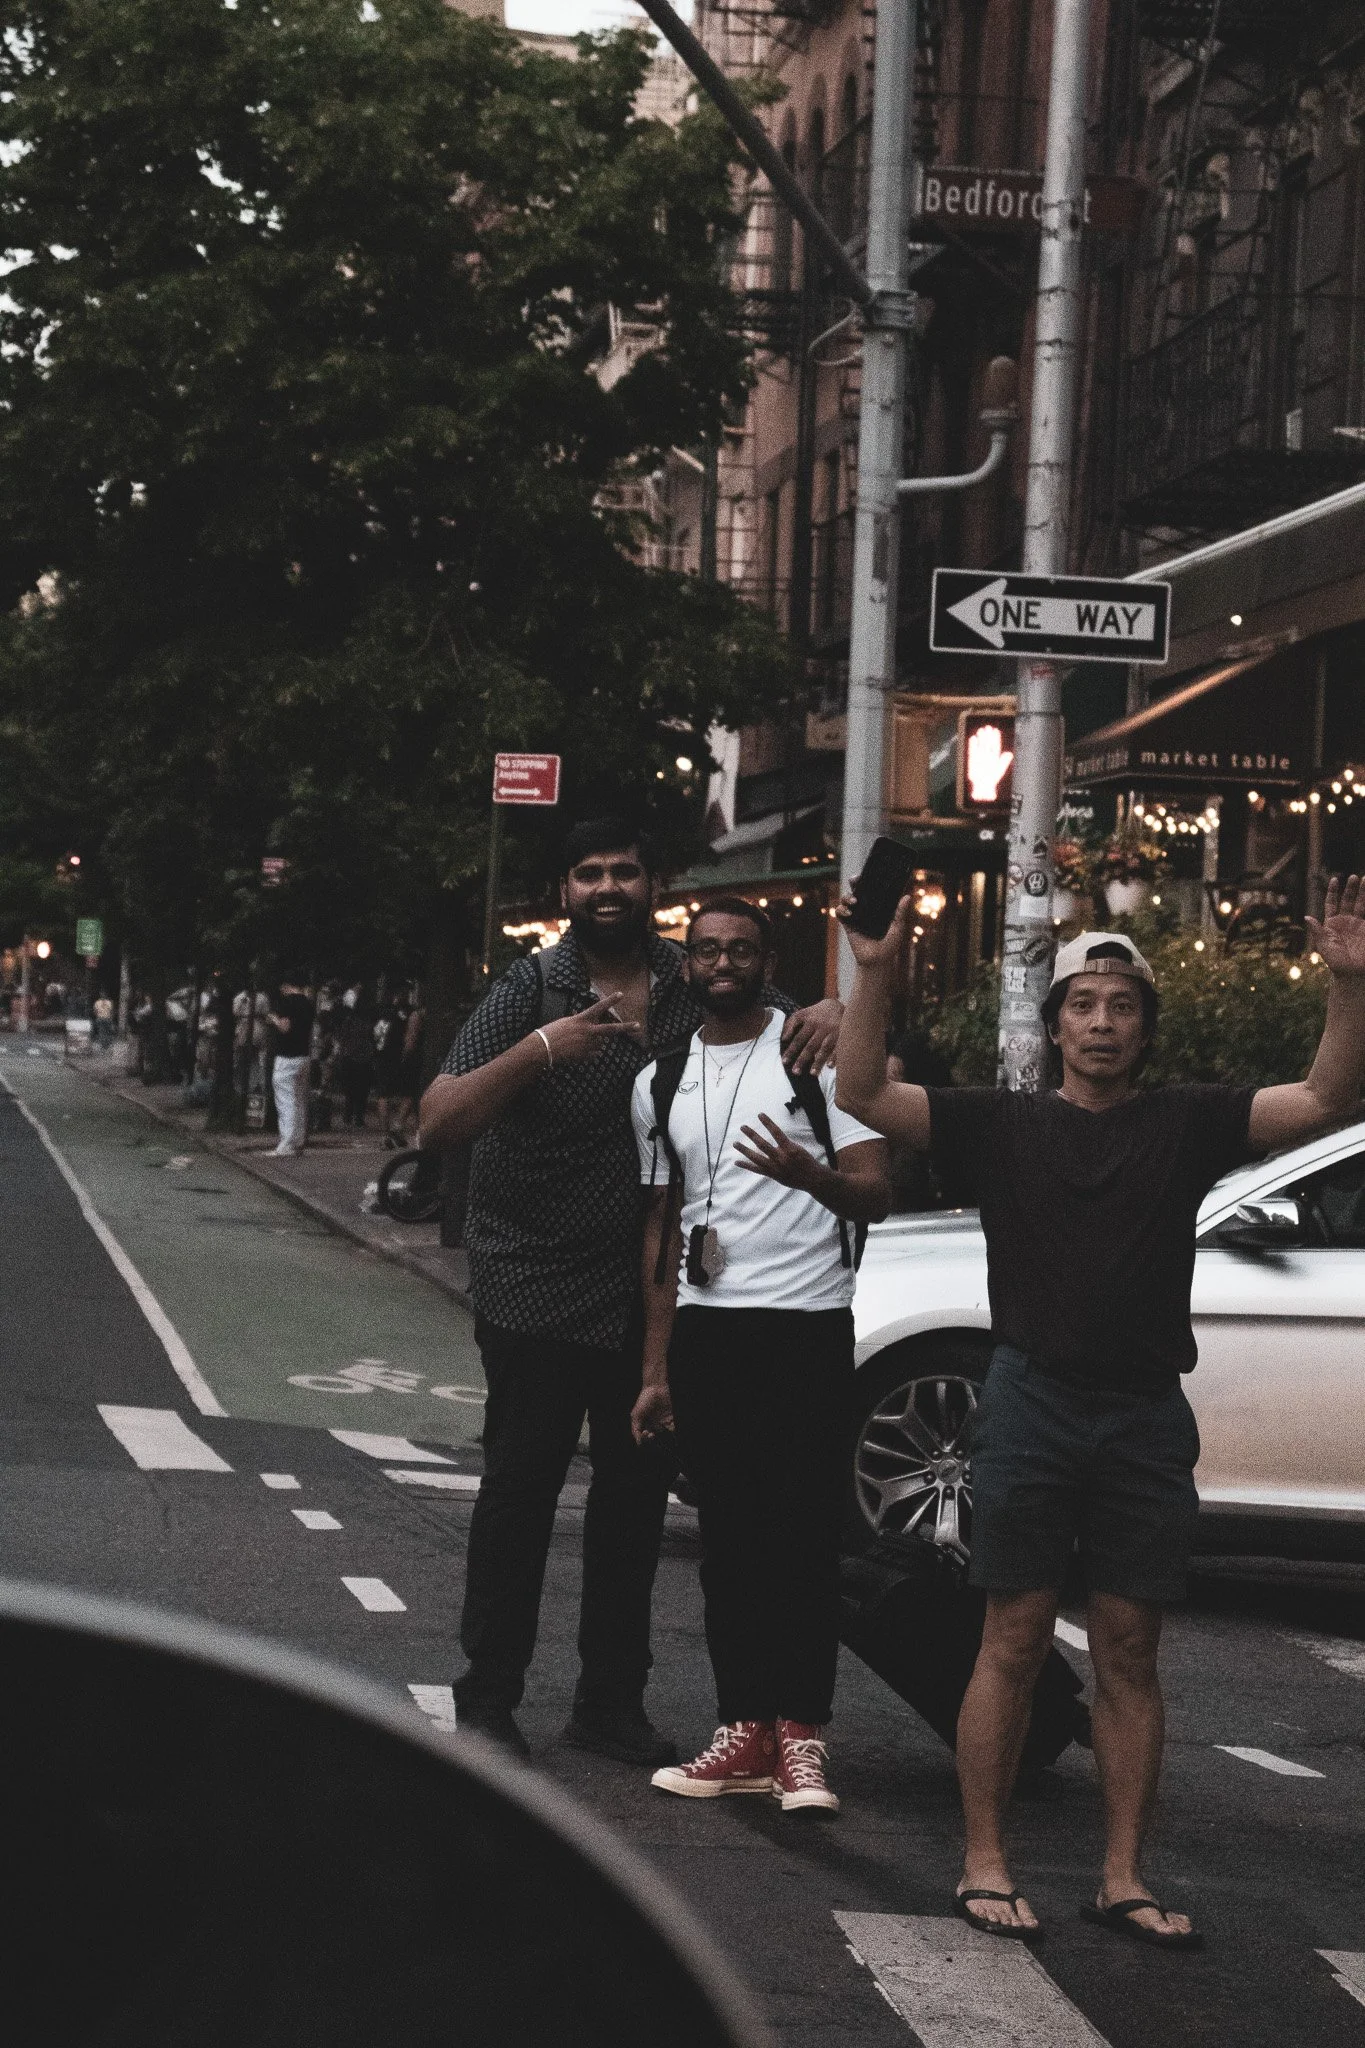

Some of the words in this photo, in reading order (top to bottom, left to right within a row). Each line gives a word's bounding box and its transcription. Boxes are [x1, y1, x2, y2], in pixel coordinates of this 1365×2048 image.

[979, 598, 1042, 630] ONE
[1076, 603, 1142, 636] WAY
[1140, 751, 1219, 768] market
[1231, 753, 1291, 770] table
